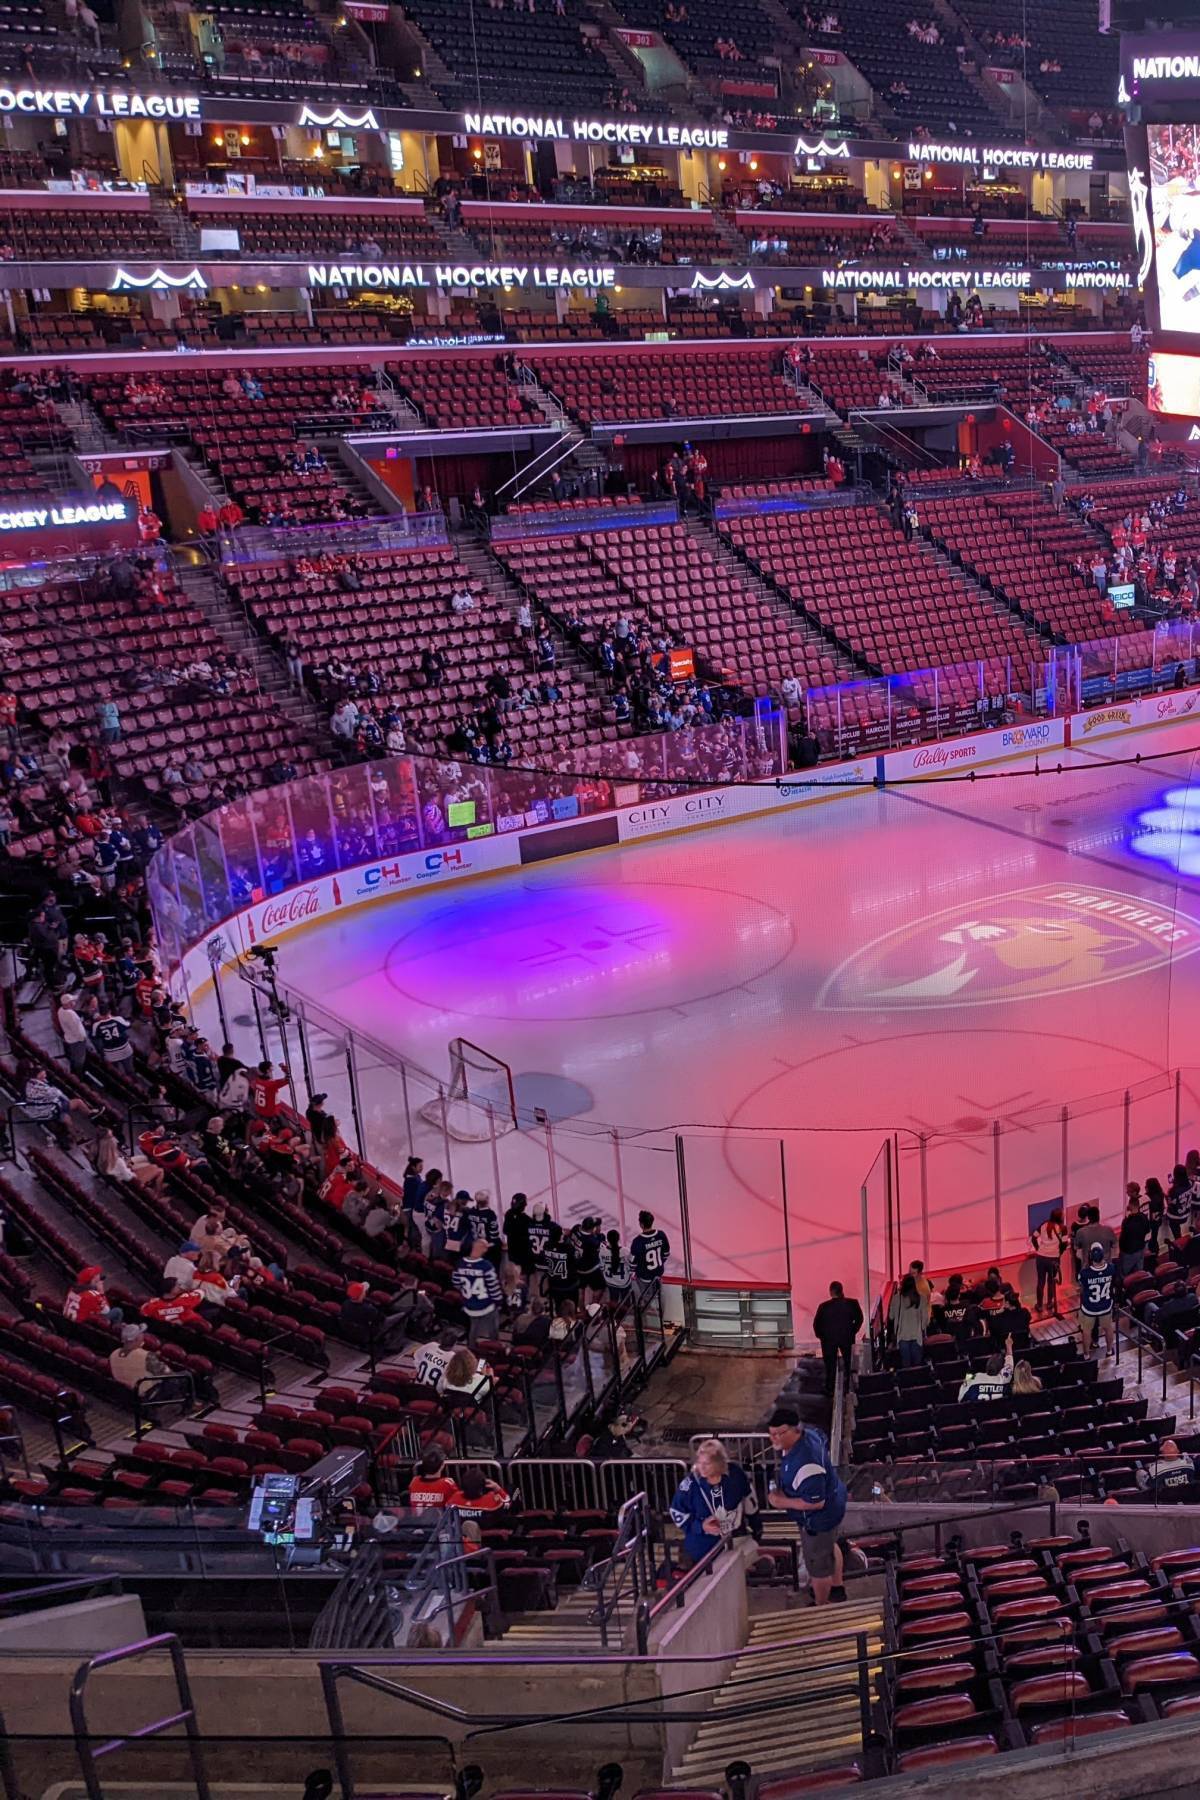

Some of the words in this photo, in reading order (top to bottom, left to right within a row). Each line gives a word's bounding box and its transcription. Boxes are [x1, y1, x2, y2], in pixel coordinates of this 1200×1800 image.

[0, 89, 90, 116] OCKEY
[96, 94, 200, 119] LEAGUE
[464, 113, 569, 139] NATIONAL
[573, 120, 653, 145] HOCKEY
[657, 126, 729, 149] LEAGUE
[908, 143, 981, 164] NATIONAL
[982, 148, 1038, 168] HOCKEY
[1040, 151, 1094, 170] LEAGUE
[308, 266, 430, 287] NATIONAL
[435, 266, 528, 288] HOCKEY
[534, 267, 615, 287] LEAGUE
[823, 270, 903, 288] NATIONAL
[907, 271, 975, 288] HOCKEY
[976, 271, 1031, 288] LEAGUE
[1066, 272, 1133, 288] NATIONAL
[51, 503, 127, 525] LEAGUE
[954, 708, 975, 717] HAIRCLU
[1088, 713, 1105, 726] GOOD
[896, 718, 921, 729] HAIRCLUB
[913, 748, 950, 769] Bally
[950, 746, 976, 760] SPORTS
[685, 795, 725, 812] CITY
[629, 805, 670, 823] CITY
[416, 870, 441, 880] Cooper
[450, 861, 473, 873] Hunter
[356, 883, 379, 895] Cooper
[1045, 890, 1192, 944] PANTHERS
[101, 1027, 120, 1041] 34
[645, 1247, 662, 1270] 91
[461, 1277, 488, 1300] 34
[1088, 1282, 1112, 1302] 34
[424, 1352, 448, 1369] WILCOX
[1164, 1474, 1189, 1487] KESSEL
